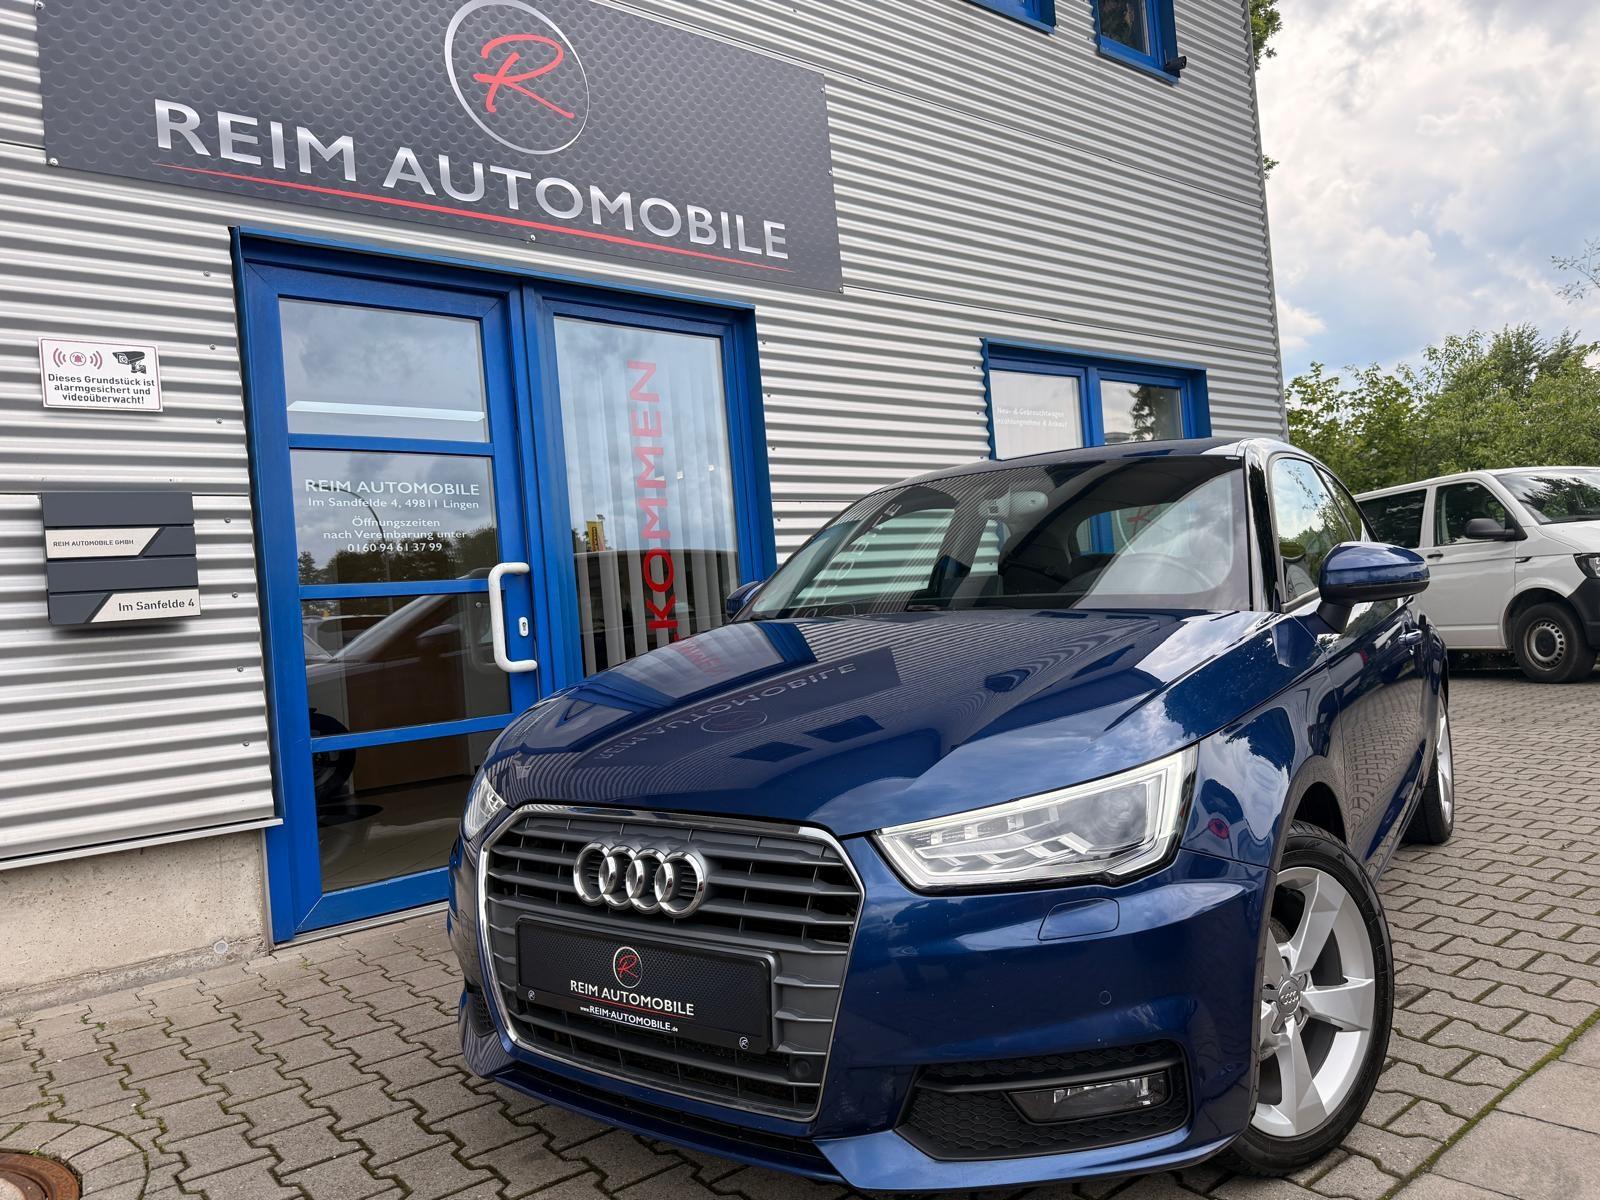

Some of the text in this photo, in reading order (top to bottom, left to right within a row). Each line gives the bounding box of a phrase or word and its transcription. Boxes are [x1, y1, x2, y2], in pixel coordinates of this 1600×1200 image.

[474, 33, 574, 119] R
[154, 98, 790, 260] REIM AUTOMOBILE
[48, 373, 155, 387] Dieses Grundstück ist
[54, 383, 151, 395] alarmgesichert und
[62, 393, 145, 404] videoüberwacht!
[305, 479, 480, 496] REIM AUTOMOBILE
[308, 498, 325, 507] Im
[329, 498, 388, 508] Sandfelde
[405, 499, 438, 508] 49811
[443, 500, 479, 511] Lingen
[627, 359, 679, 641] KOMMEN
[352, 515, 441, 528] Öffnungszeiten
[323, 530, 467, 541] nach Vereinbarung unter
[347, 542, 443, 552] 0160 94 61 37 99
[118, 598, 195, 612] Im Sanfelde 4
[618, 954, 639, 978] R
[570, 980, 695, 1016] REIM AUTOMOBILE
[580, 1005, 679, 1032] www.REIM-AUTOMOBILE.de
